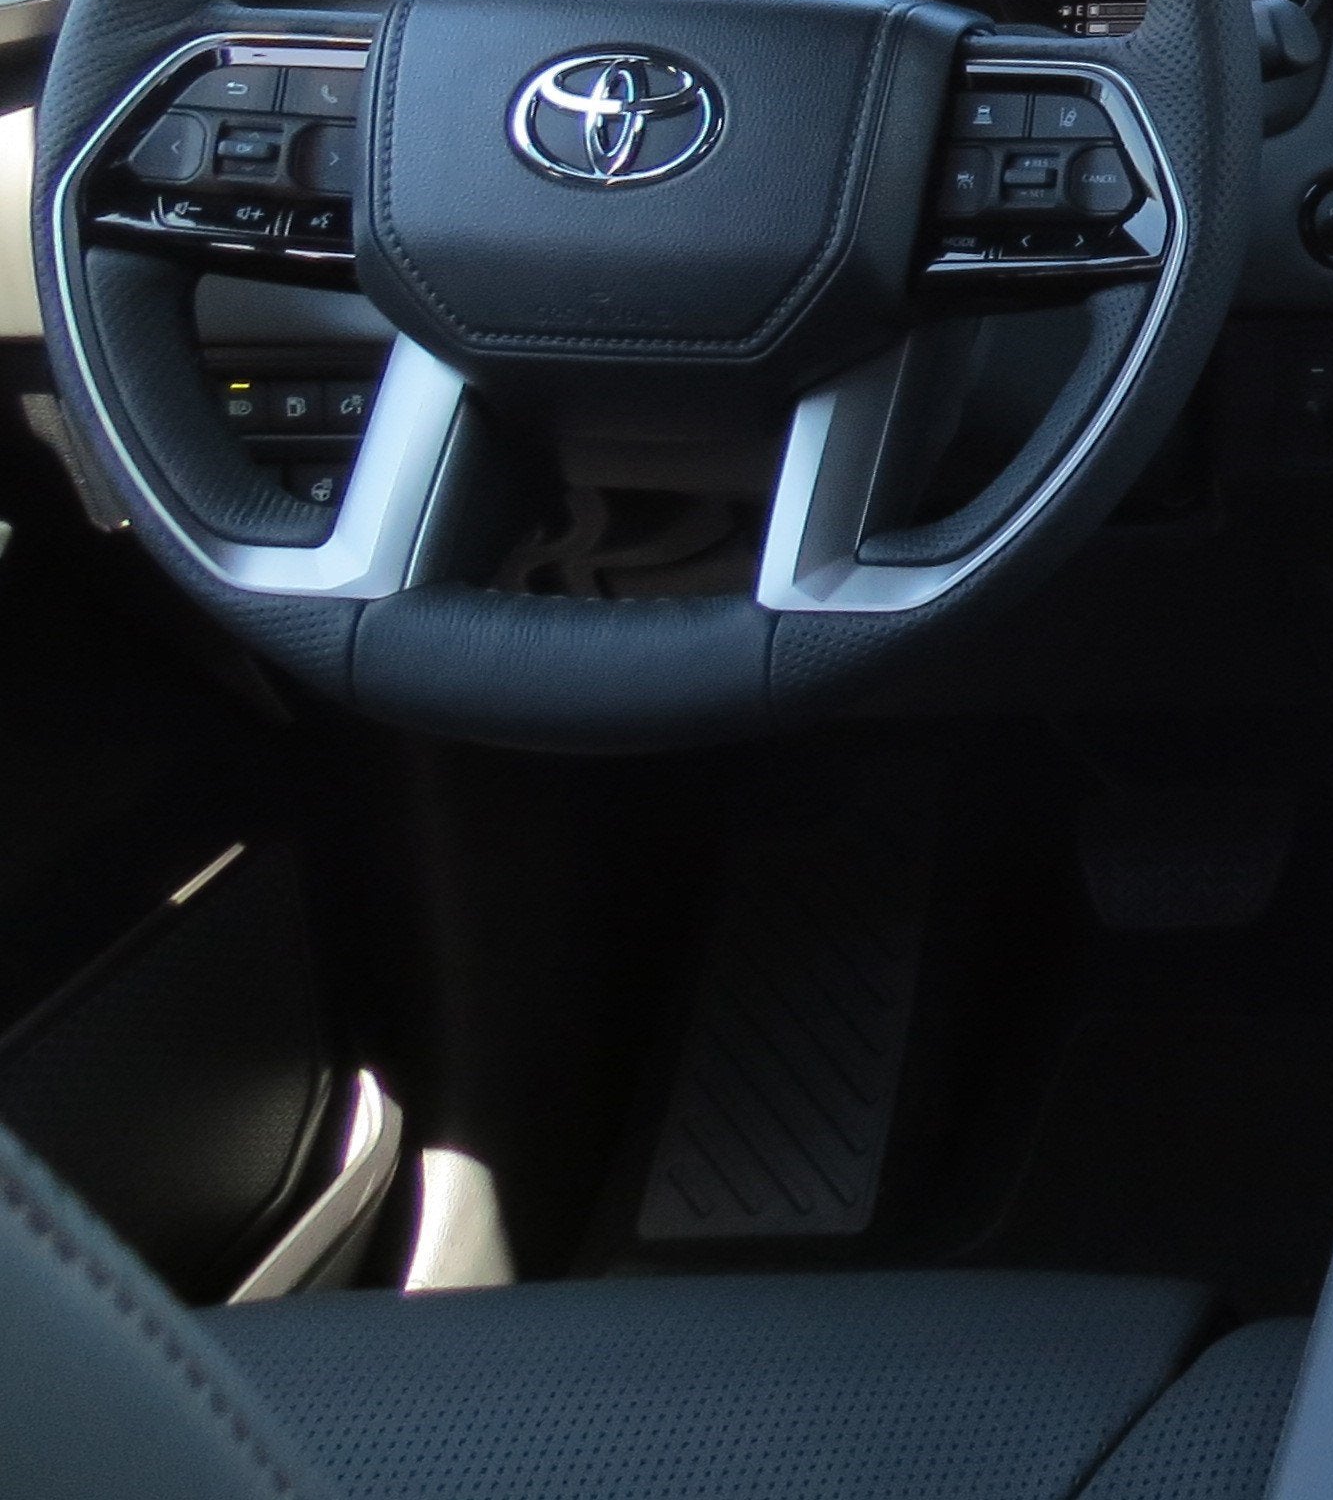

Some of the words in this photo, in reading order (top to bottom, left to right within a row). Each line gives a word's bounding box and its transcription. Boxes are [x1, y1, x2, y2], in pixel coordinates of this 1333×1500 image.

[1076, 5, 1083, 16] E
[1075, 23, 1083, 34] C
[1082, 173, 1118, 184] CANCEL
